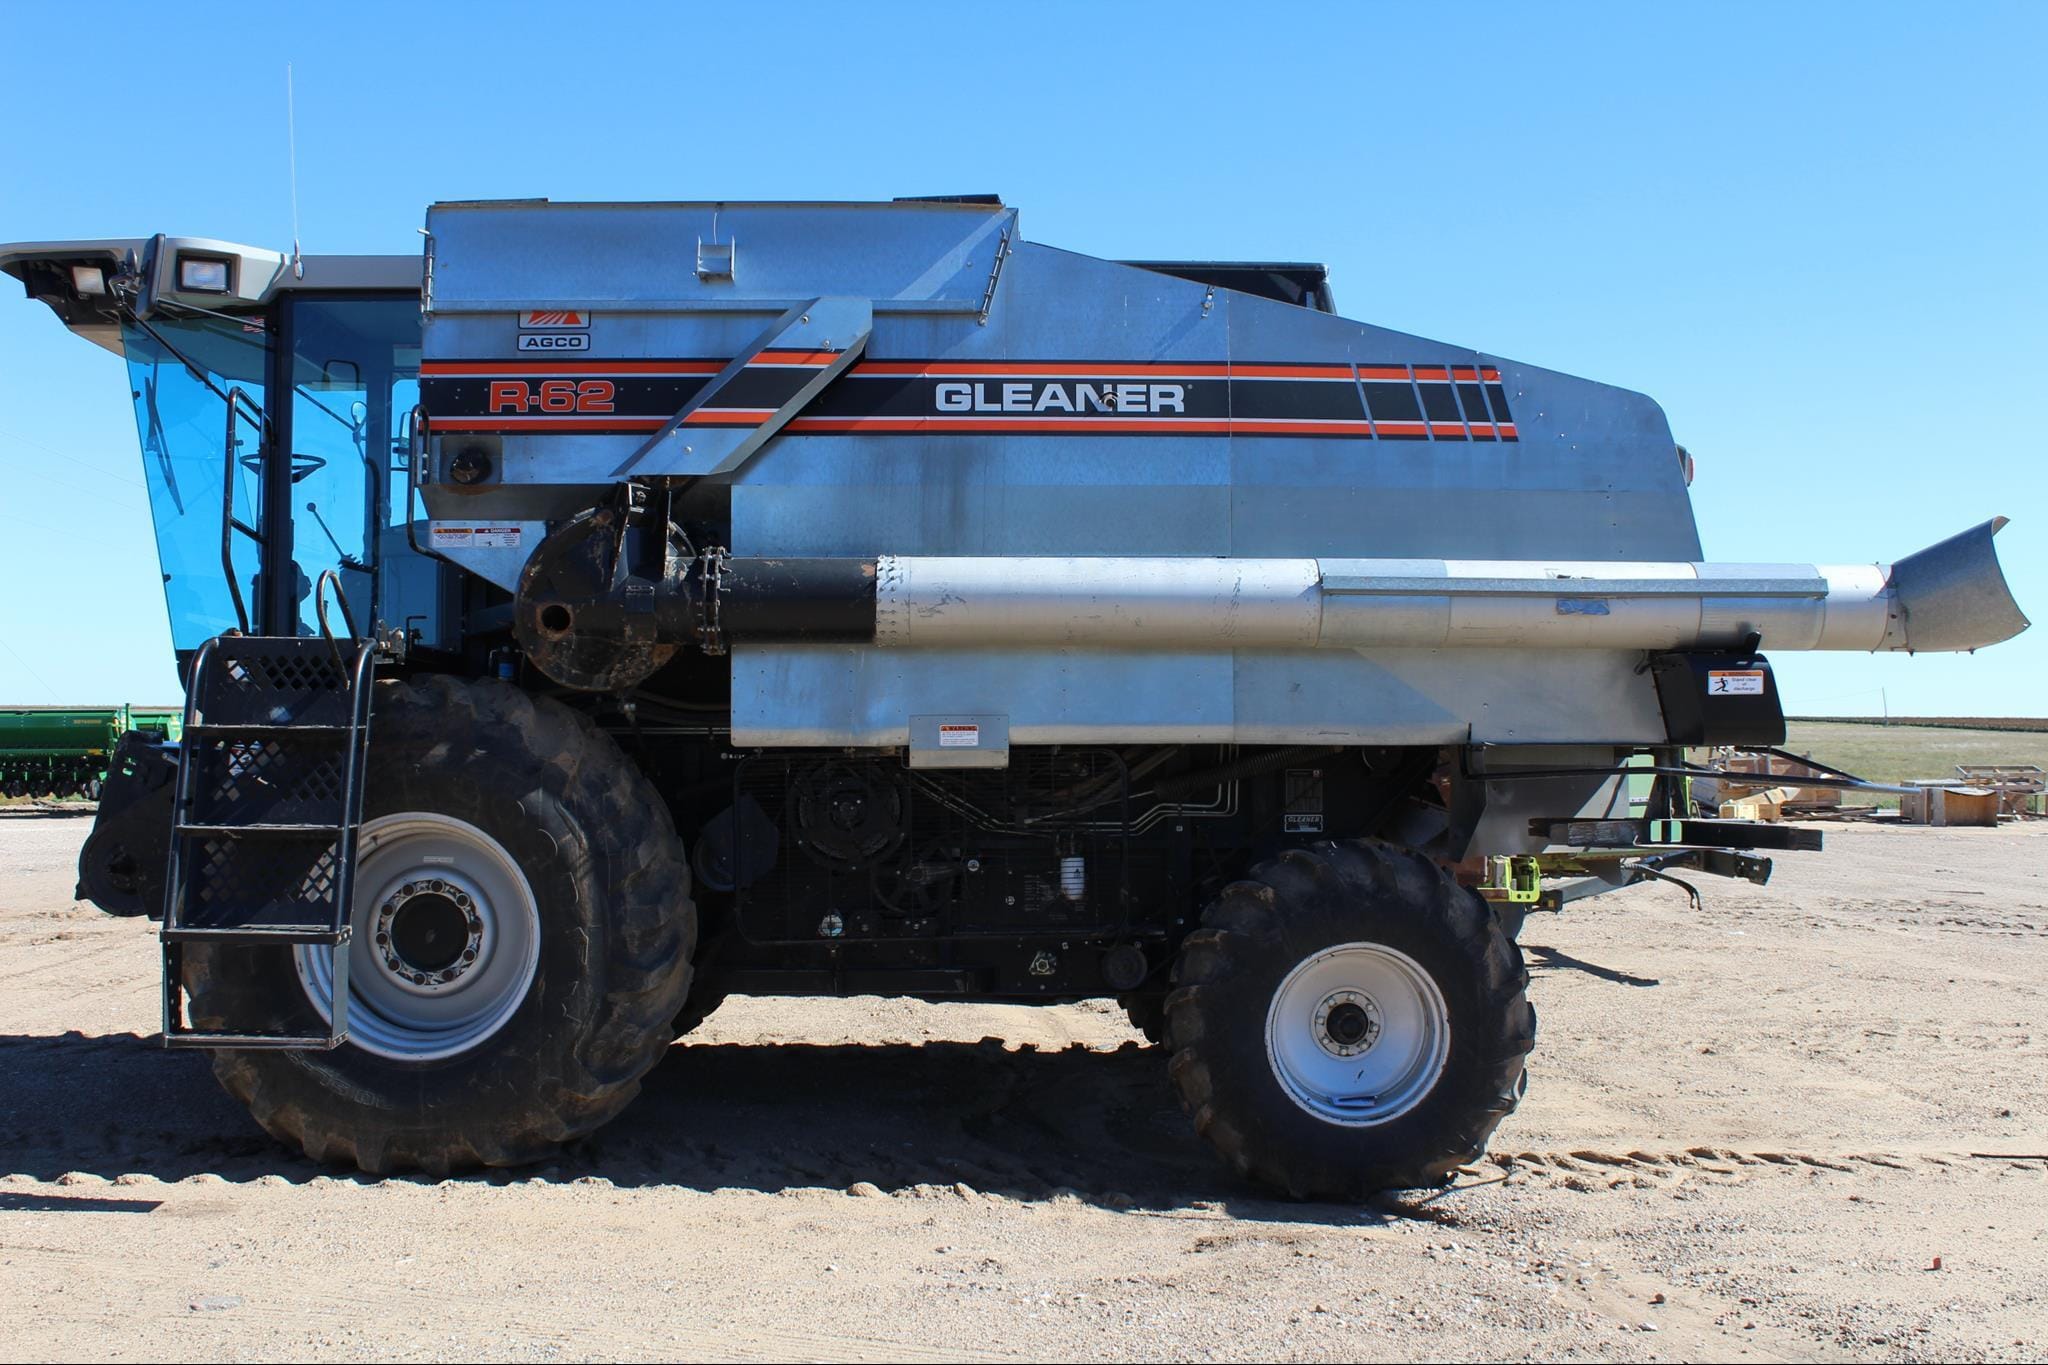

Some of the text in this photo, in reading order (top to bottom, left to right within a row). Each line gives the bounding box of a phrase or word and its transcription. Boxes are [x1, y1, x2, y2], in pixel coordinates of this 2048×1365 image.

[526, 337, 582, 348] AGCO
[489, 380, 615, 413] R-62
[935, 383, 1185, 413] GLEANER
